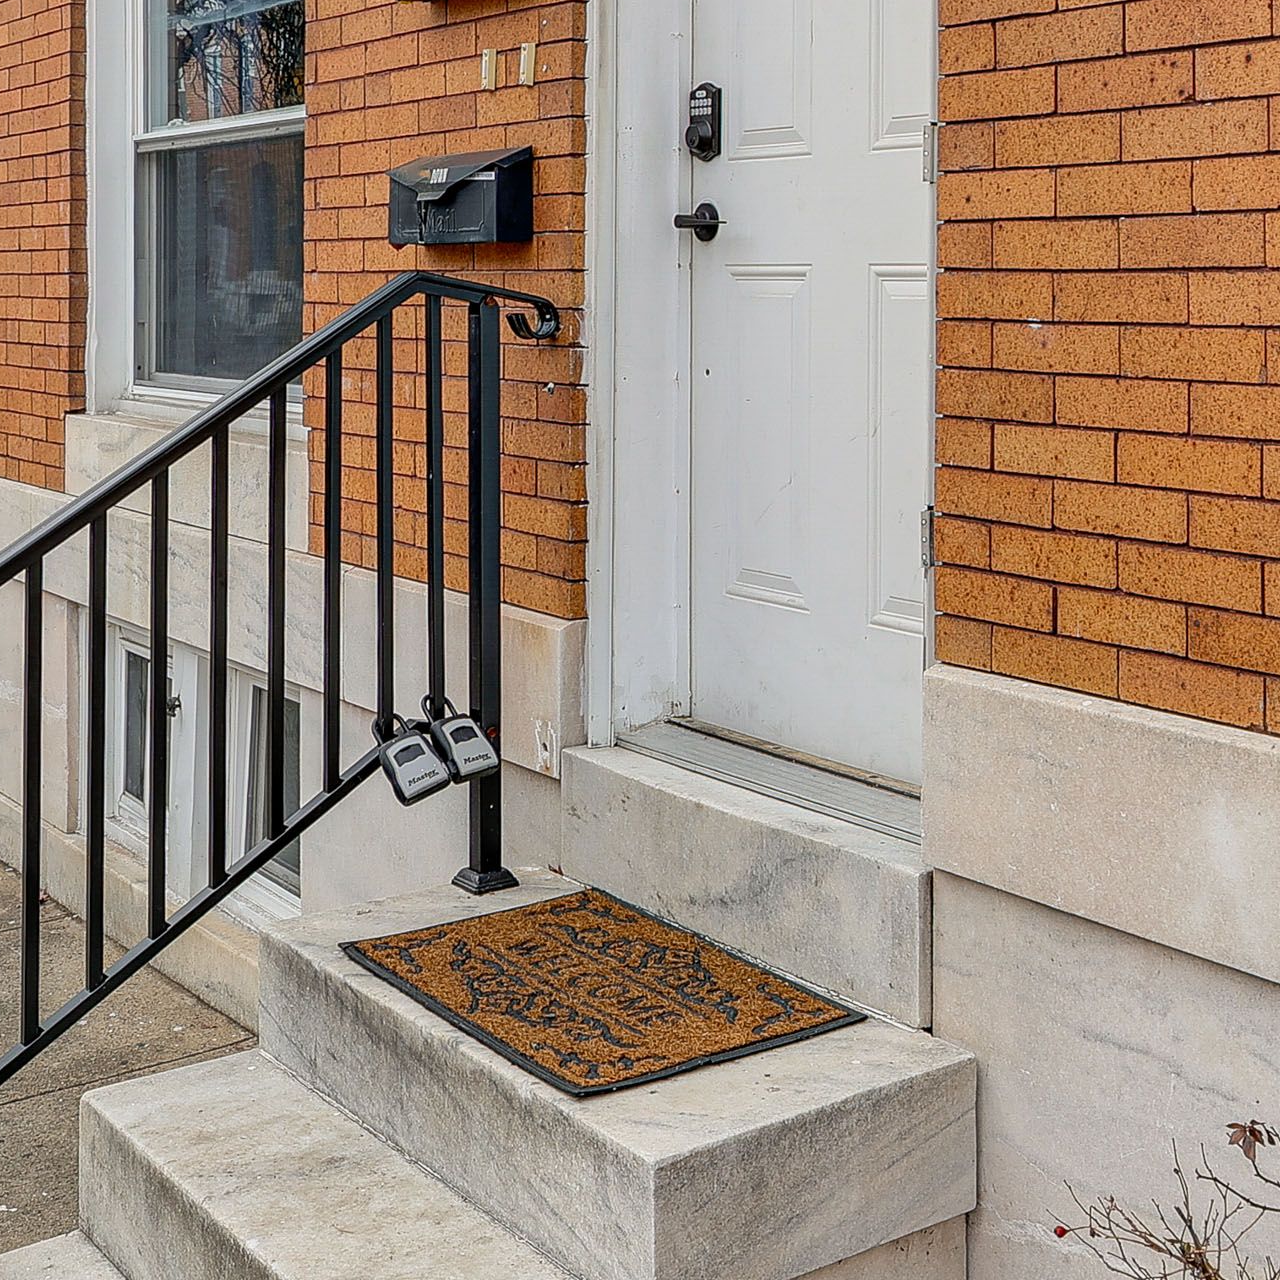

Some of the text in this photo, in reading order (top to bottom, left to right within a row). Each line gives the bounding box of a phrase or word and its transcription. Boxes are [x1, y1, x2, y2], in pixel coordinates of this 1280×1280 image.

[422, 208, 457, 233] Mail
[463, 753, 489, 764] Master
[408, 769, 437, 786] Master
[506, 940, 686, 1026] WELCOME
